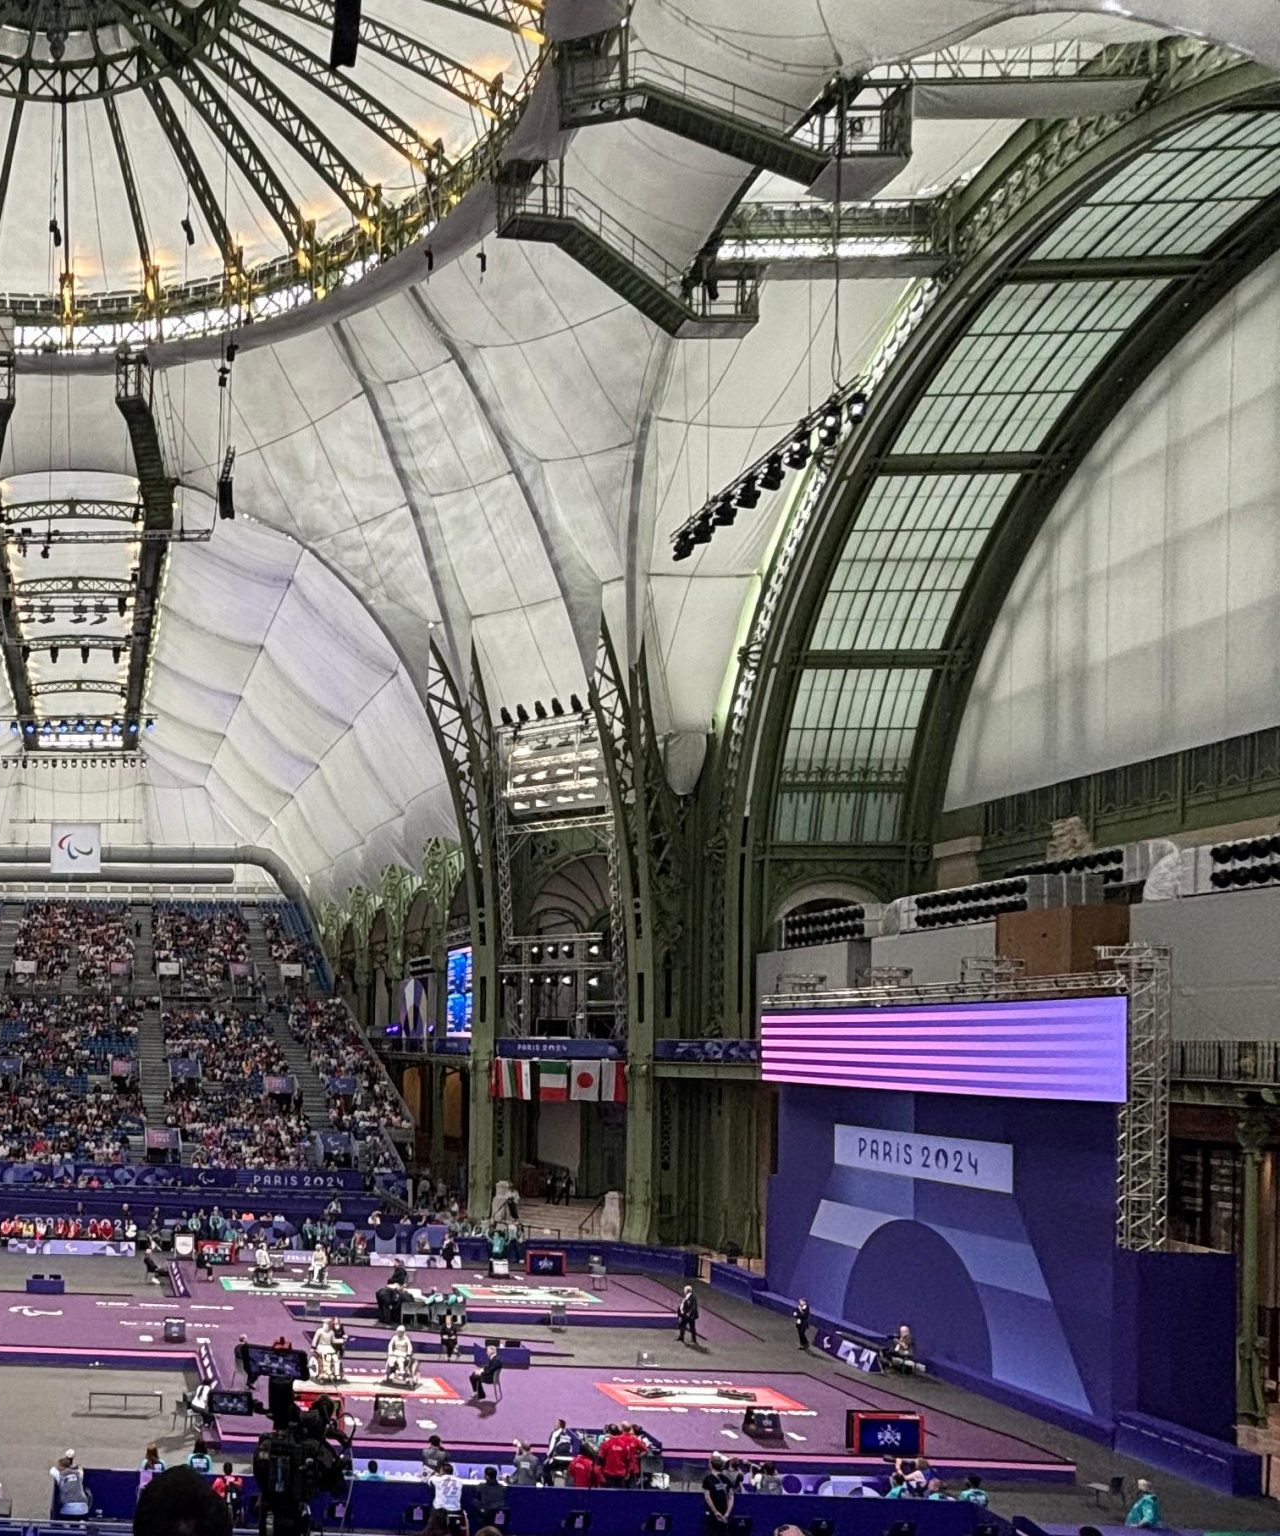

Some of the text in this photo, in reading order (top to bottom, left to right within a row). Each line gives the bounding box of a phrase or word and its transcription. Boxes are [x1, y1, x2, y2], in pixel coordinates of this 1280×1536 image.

[858, 1137, 978, 1176] PARIS 2024
[253, 1175, 344, 1187] PARIS 2024
